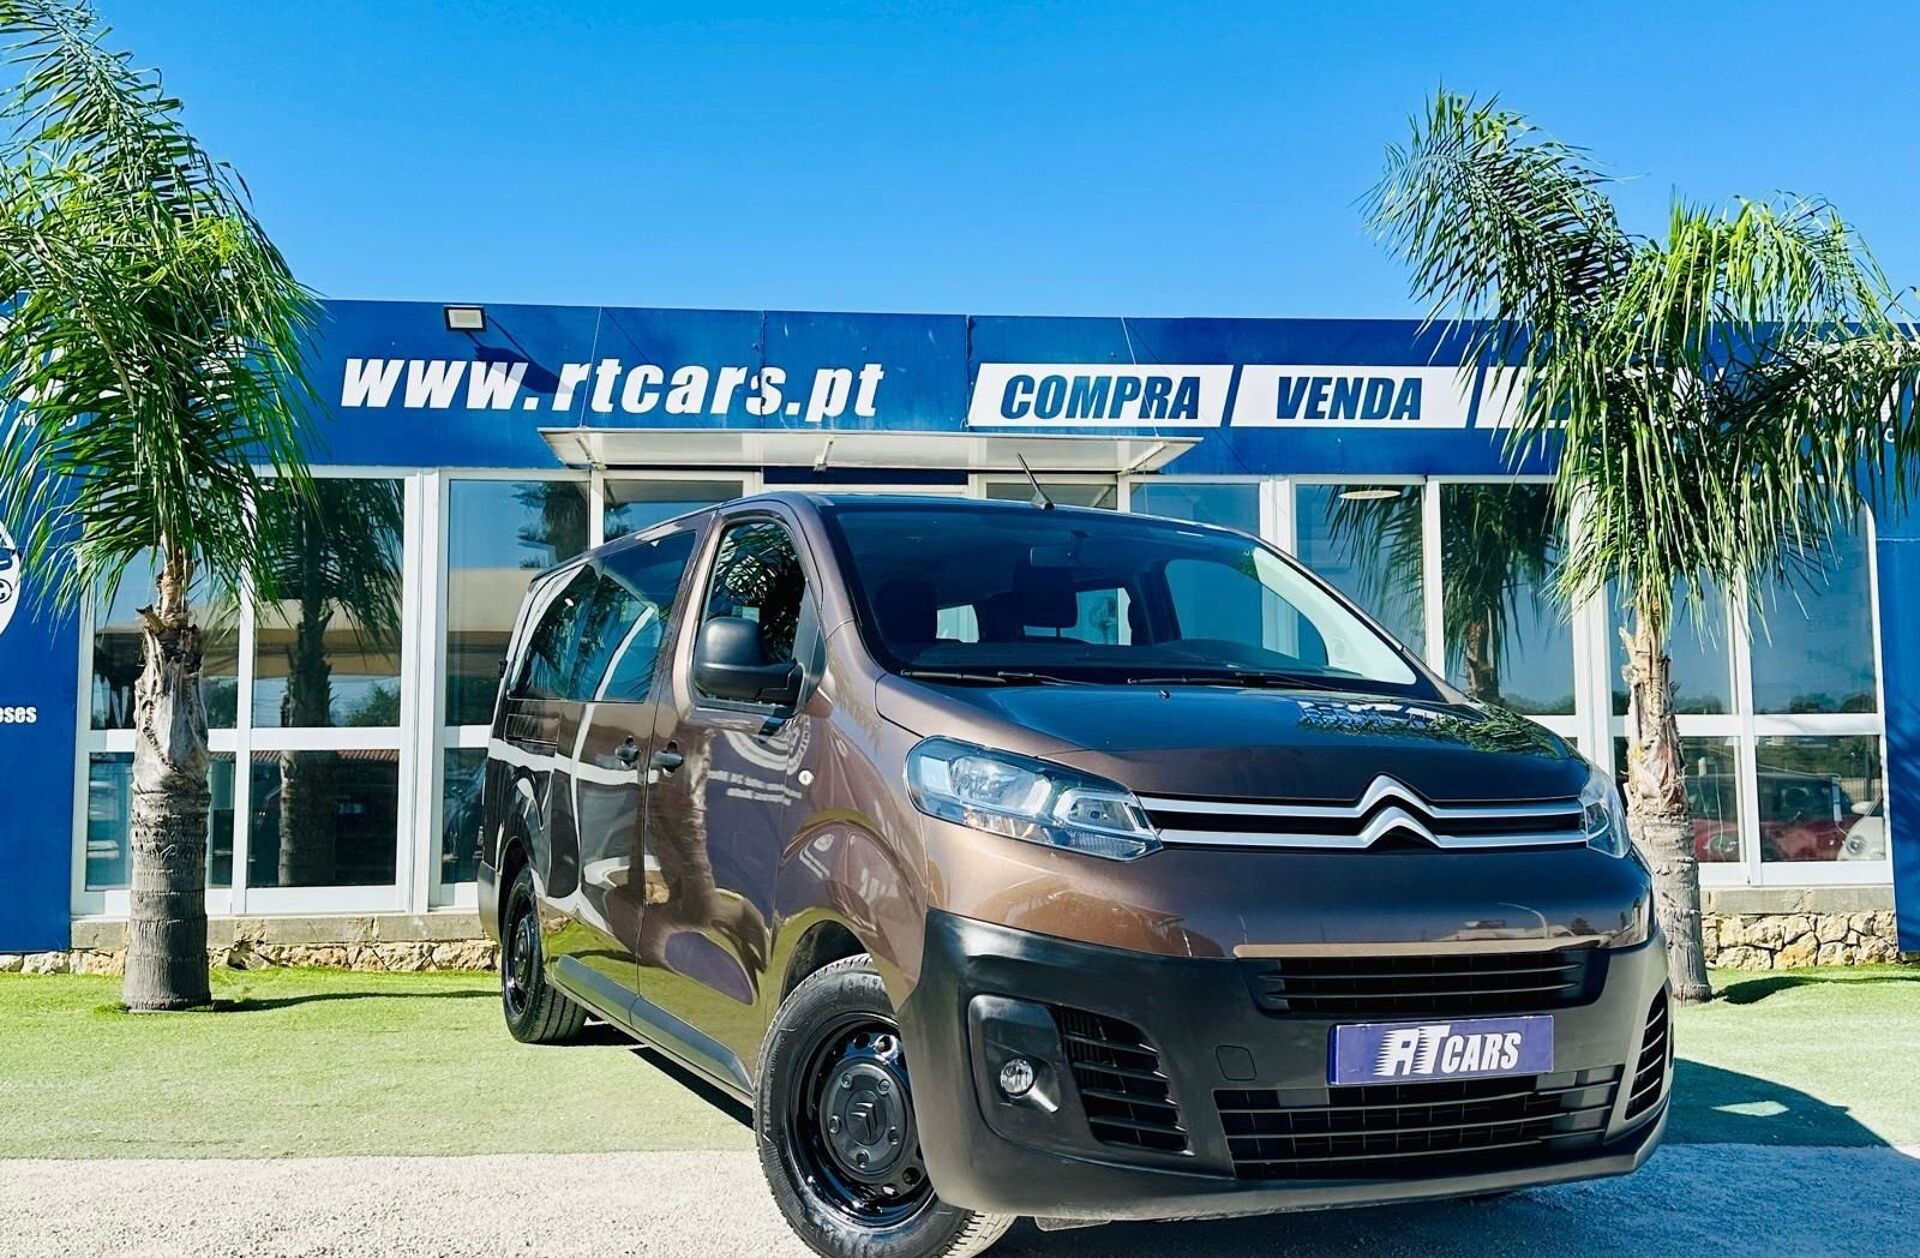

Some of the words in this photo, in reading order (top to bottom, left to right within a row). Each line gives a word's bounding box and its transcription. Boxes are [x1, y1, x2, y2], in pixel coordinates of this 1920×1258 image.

[341, 357, 885, 422] www.rtcars.pt
[1000, 375, 1200, 420] COMPRA
[1276, 376, 1422, 420] VENDA
